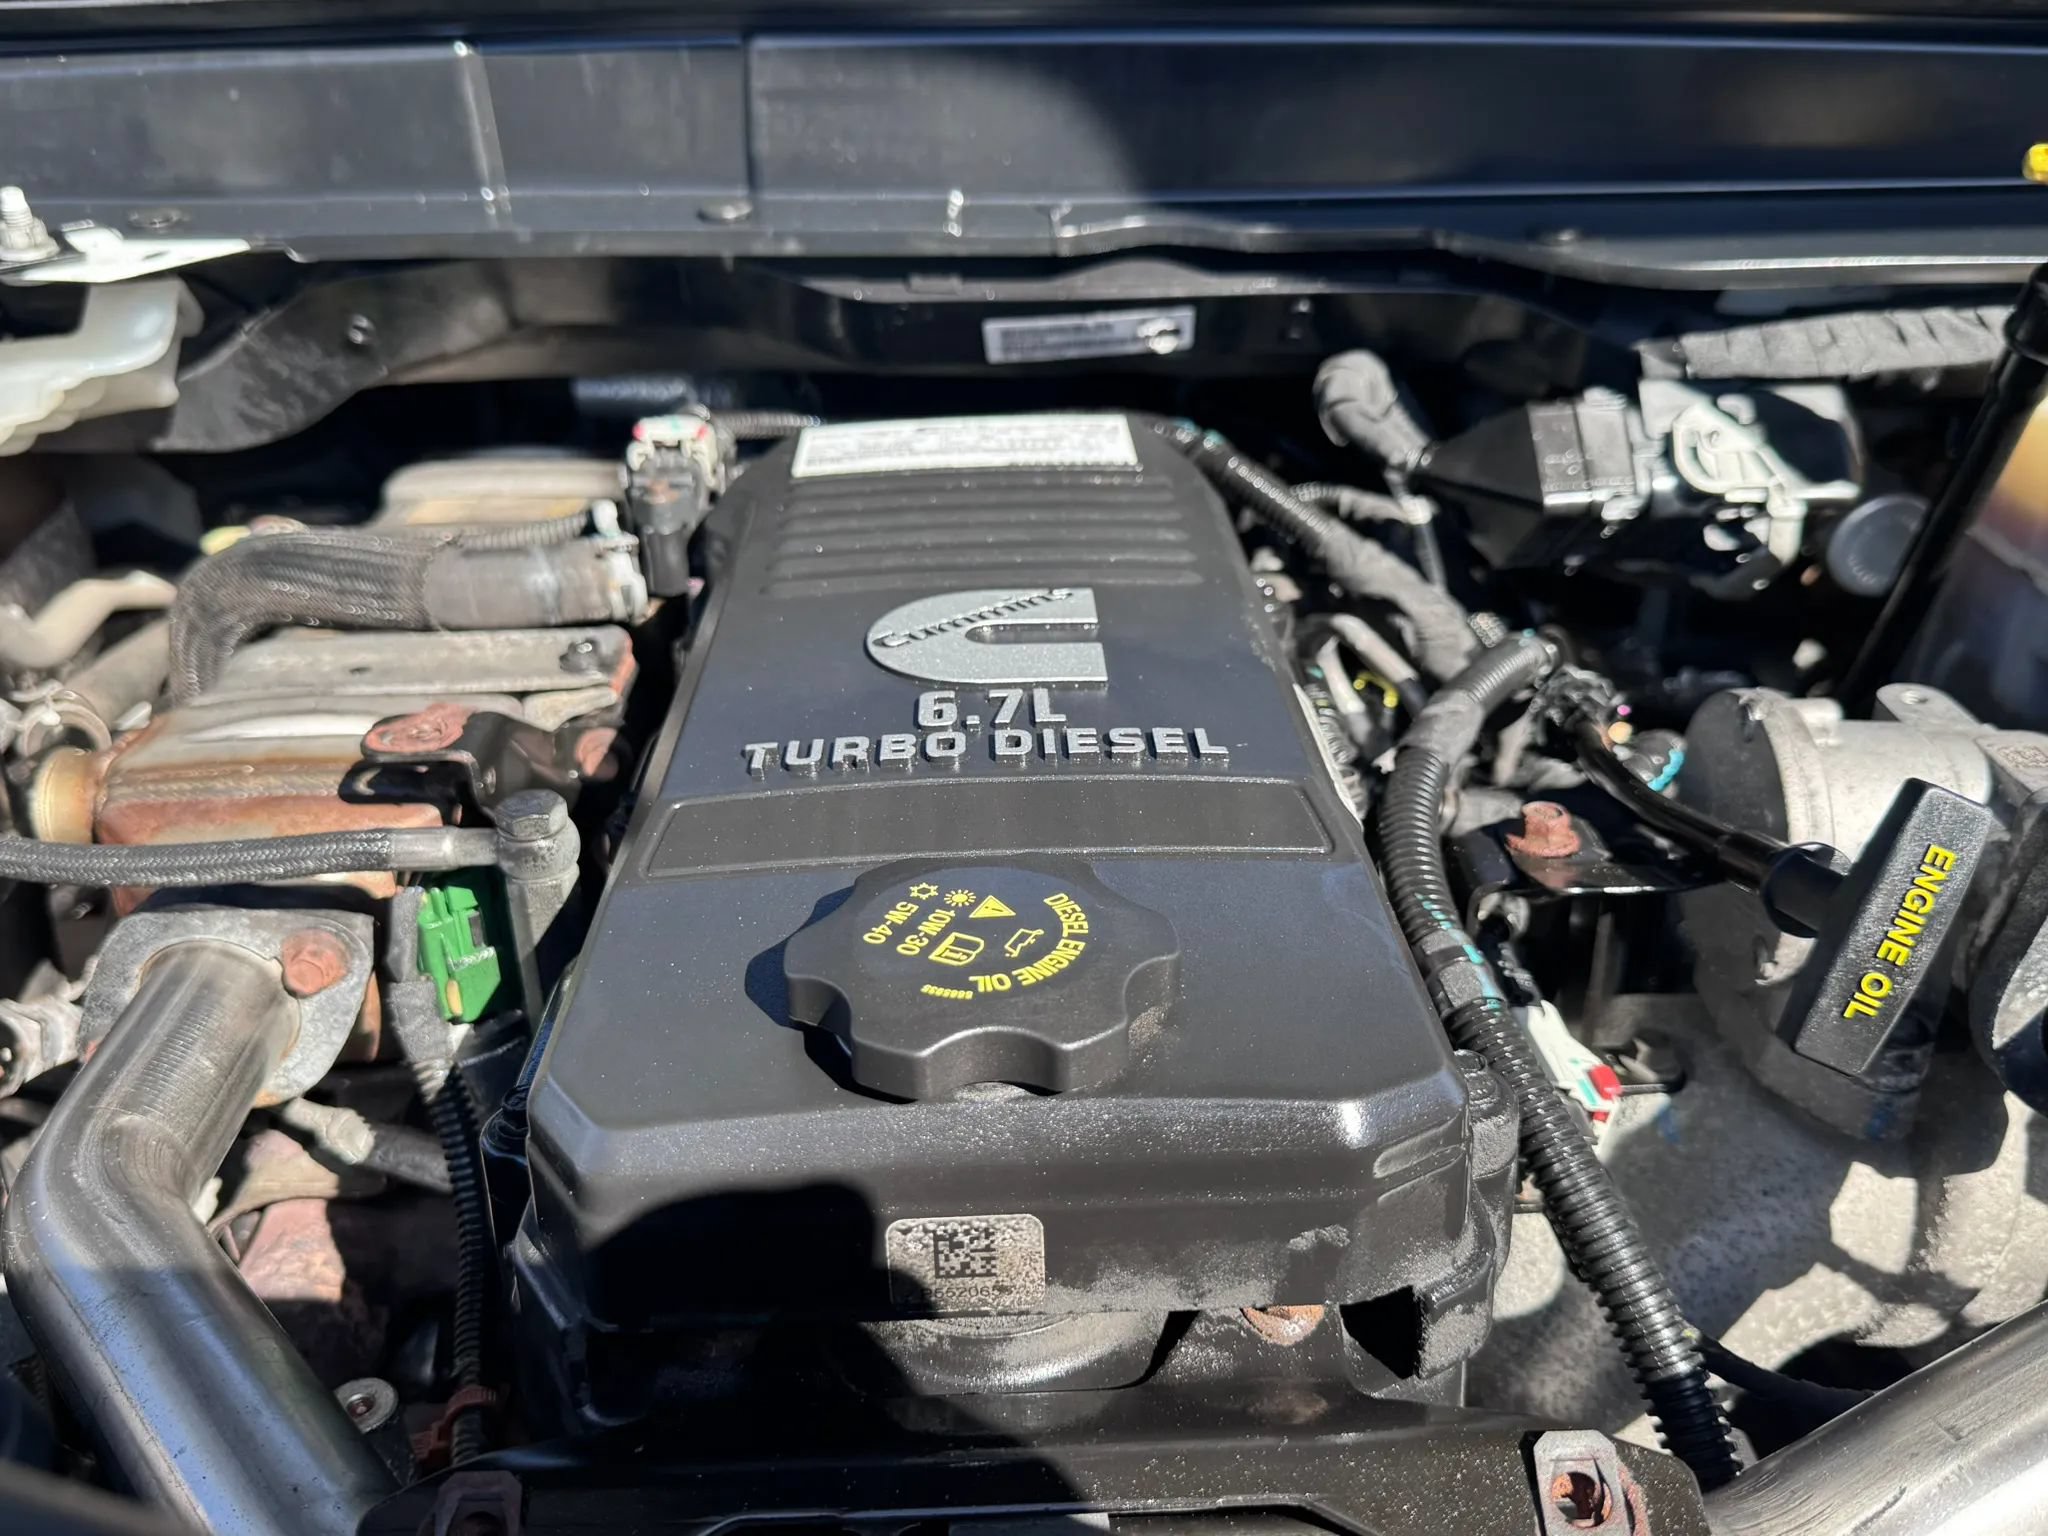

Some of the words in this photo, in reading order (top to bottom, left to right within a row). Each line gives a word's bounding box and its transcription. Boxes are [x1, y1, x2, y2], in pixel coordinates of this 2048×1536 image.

[873, 588, 1074, 647] Cummins
[918, 688, 1067, 728] 6.7L
[744, 730, 967, 776] TURBO
[994, 727, 1231, 759] DIESEL
[862, 901, 919, 945] 5W-40
[1043, 892, 1089, 938] DIESEL
[1876, 843, 1957, 967] ENGINE
[896, 908, 956, 956] 10W-30
[968, 973, 1012, 993] OIL
[1011, 938, 1086, 987] ENGINE
[1843, 971, 1894, 1019] OIL
